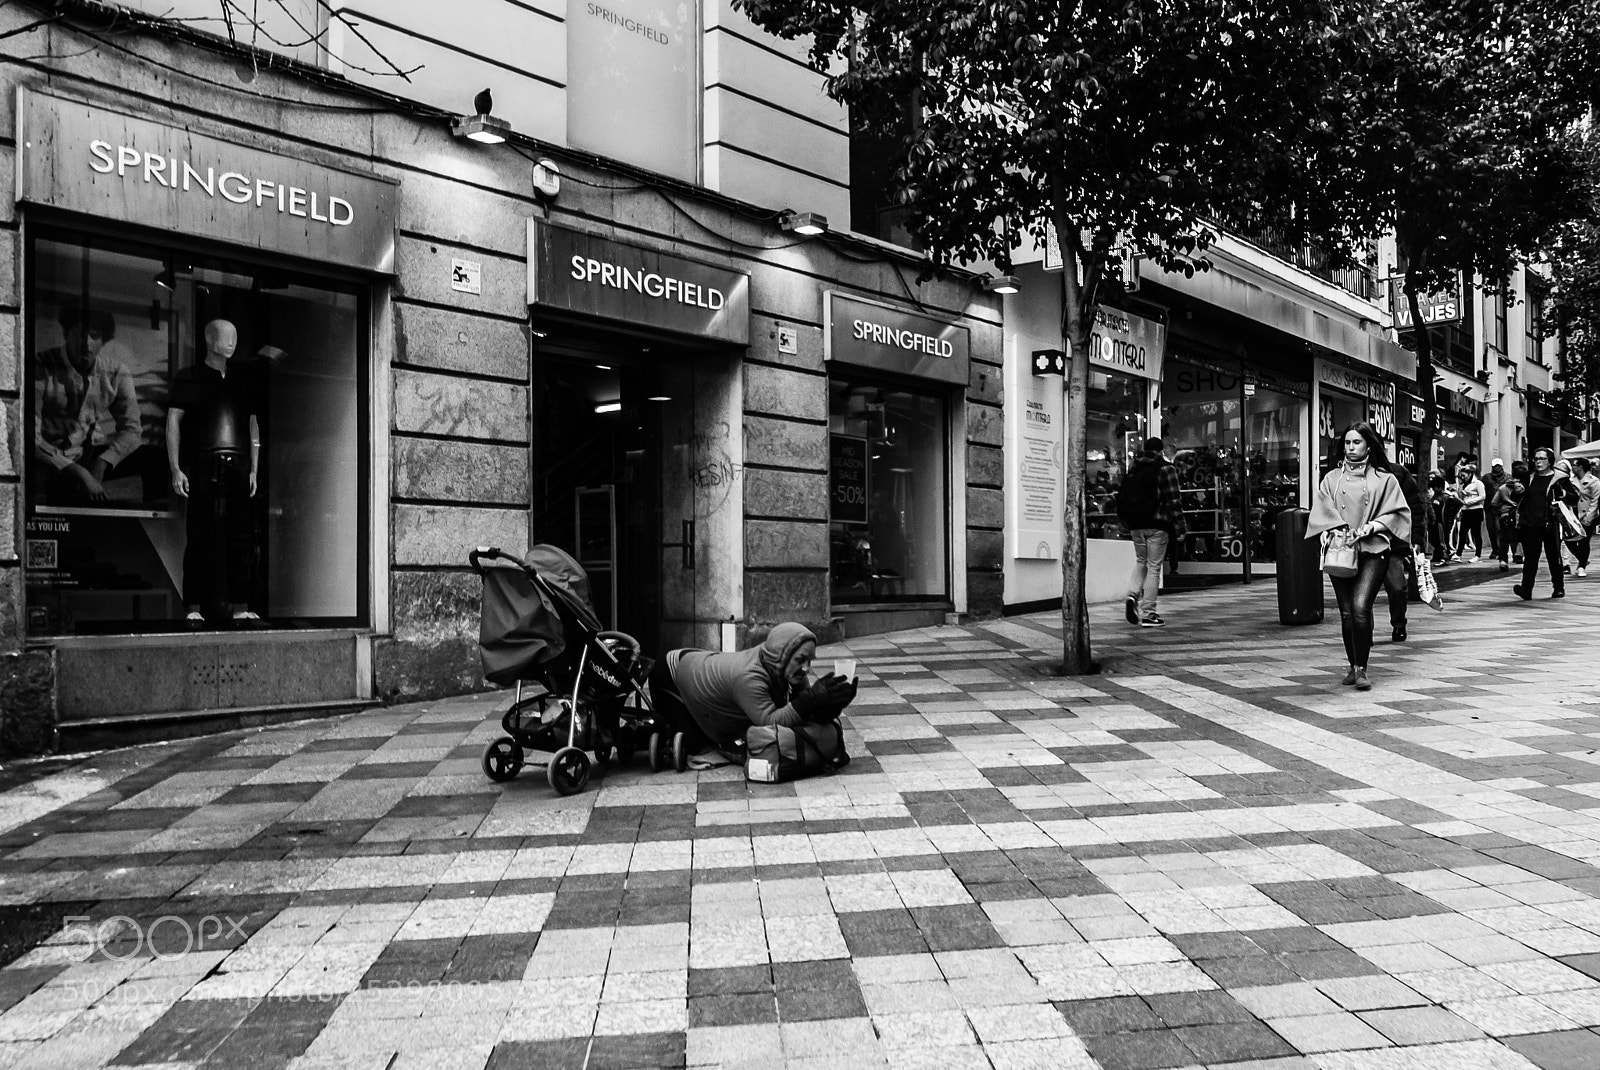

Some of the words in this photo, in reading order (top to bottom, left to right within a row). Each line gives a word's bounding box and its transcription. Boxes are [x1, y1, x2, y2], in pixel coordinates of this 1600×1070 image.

[587, 2, 669, 45] SPRINGFIELD
[89, 139, 354, 226] SPRINGFIELD
[570, 255, 725, 311] SPRINGFIELD
[1397, 303, 1456, 326] VIJES
[853, 319, 953, 358] SPRINGFIELD
[1090, 332, 1146, 371] MONTERA
[1344, 372, 1367, 393] SHOES
[1369, 403, 1395, 440] -60%
[832, 457, 864, 469] SEASON
[839, 470, 859, 481] SALE
[832, 485, 865, 504] -50%
[26, 522, 36, 531] AS
[38, 522, 53, 532] YOU
[54, 522, 71, 533] LIVE
